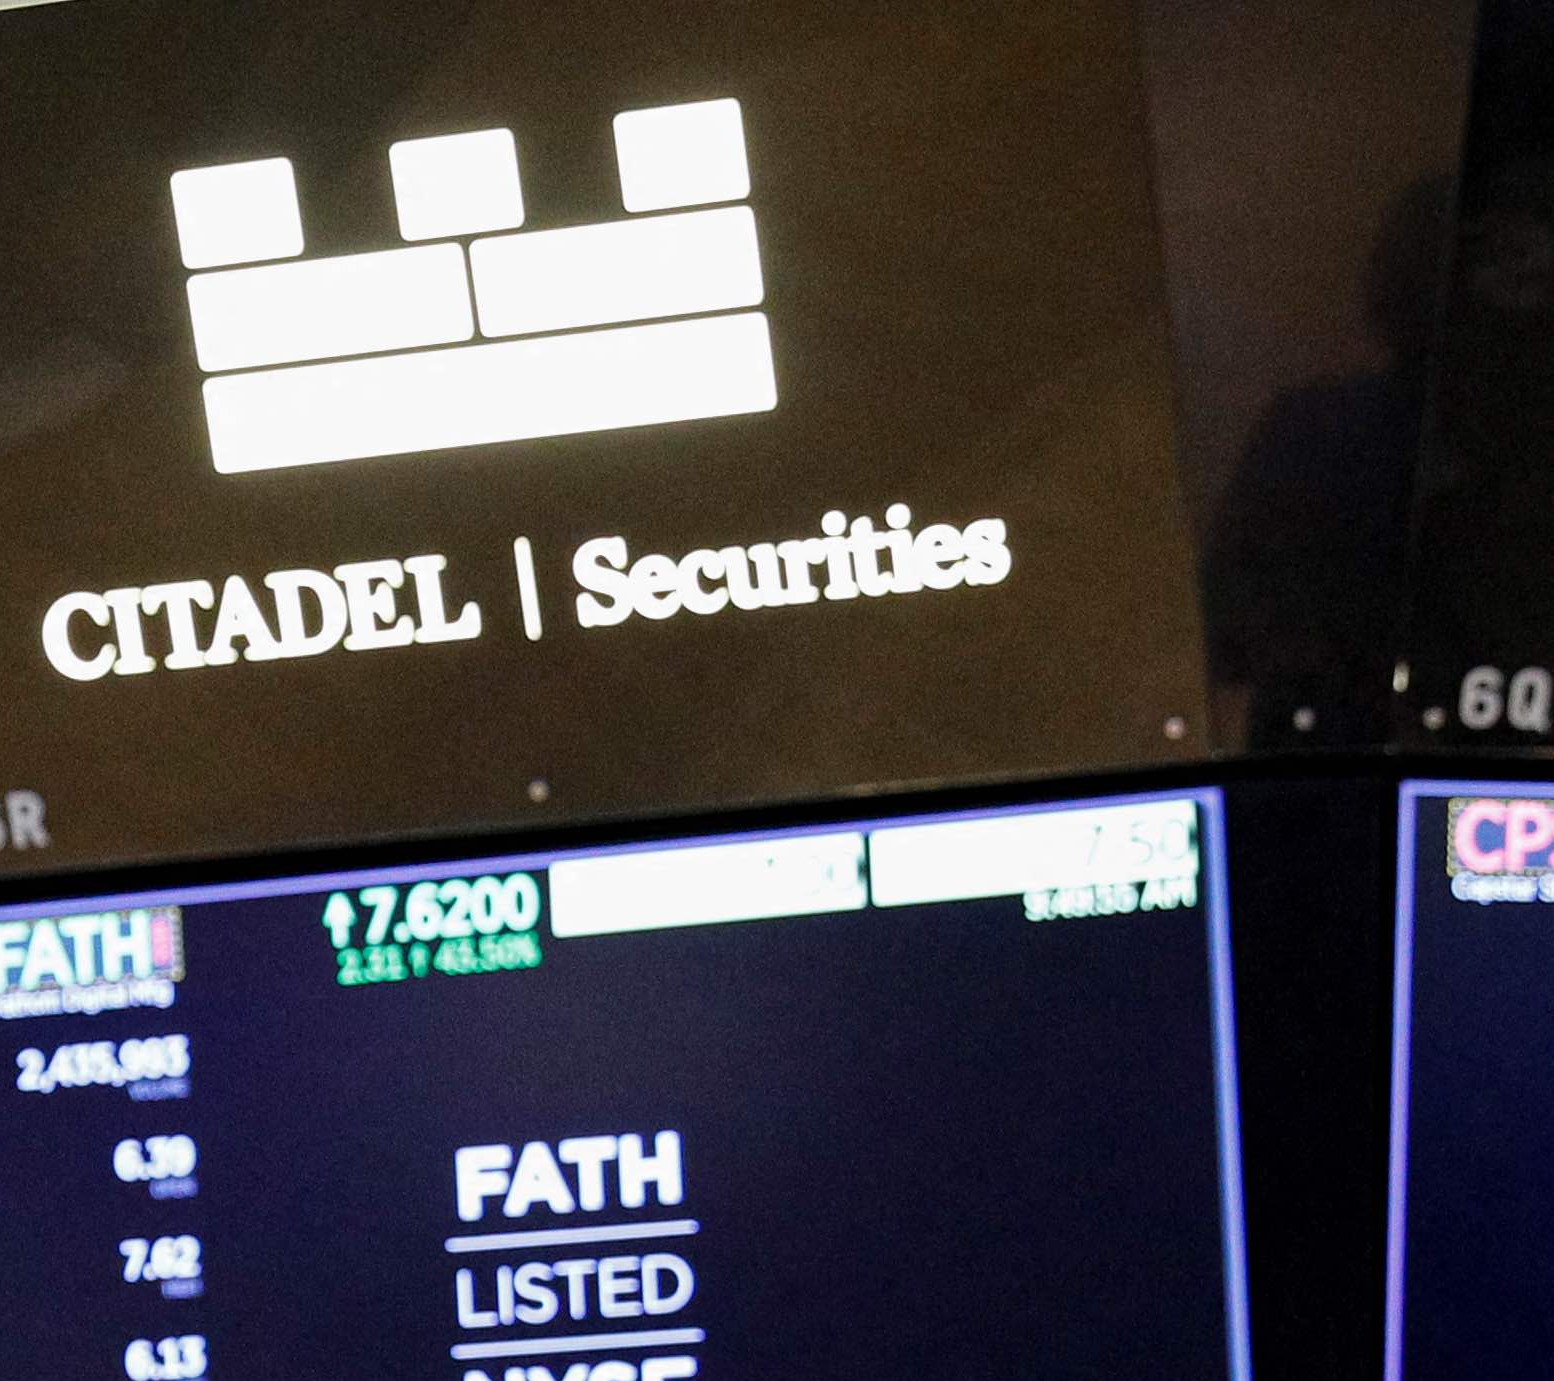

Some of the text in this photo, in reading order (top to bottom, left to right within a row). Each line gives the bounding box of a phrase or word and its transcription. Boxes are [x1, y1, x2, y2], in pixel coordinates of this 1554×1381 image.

[42, 502, 1011, 680] CITADEL Securities
[1459, 666, 1553, 733] 6Q
[359, 873, 540, 945] 7.6200
[455, 1130, 682, 1223] FATH
[119, 1235, 202, 1283] 7.62
[455, 1252, 695, 1330] LISTED
